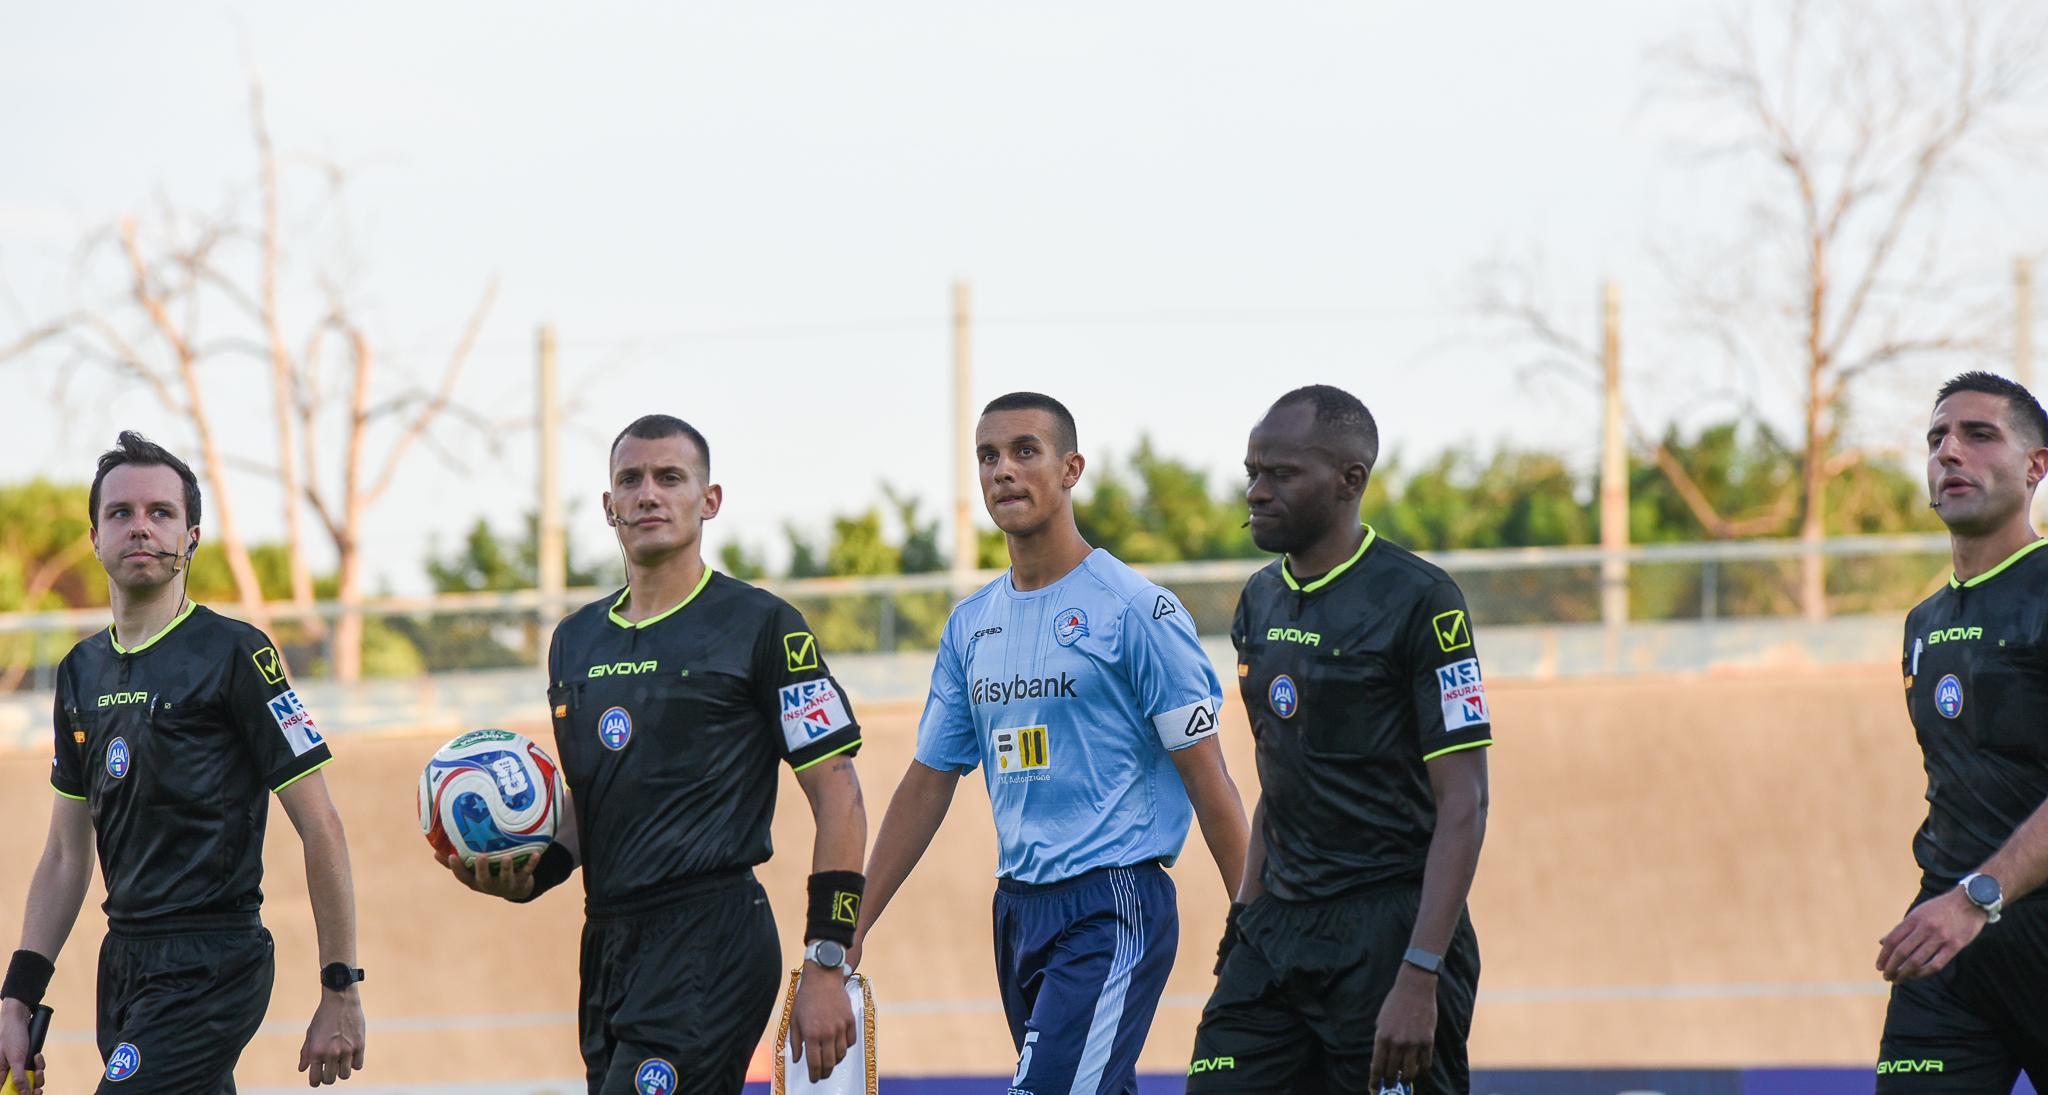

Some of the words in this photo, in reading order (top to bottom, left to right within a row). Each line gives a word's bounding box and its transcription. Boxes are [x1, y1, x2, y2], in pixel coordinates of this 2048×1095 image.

[1267, 628, 1321, 647] GIVOVA
[1928, 627, 1983, 645] GIVOVA
[588, 660, 657, 678] GIVOVA
[985, 671, 1078, 706] isybank
[97, 691, 148, 708] GIVOVA
[1013, 1032, 1039, 1086] 5
